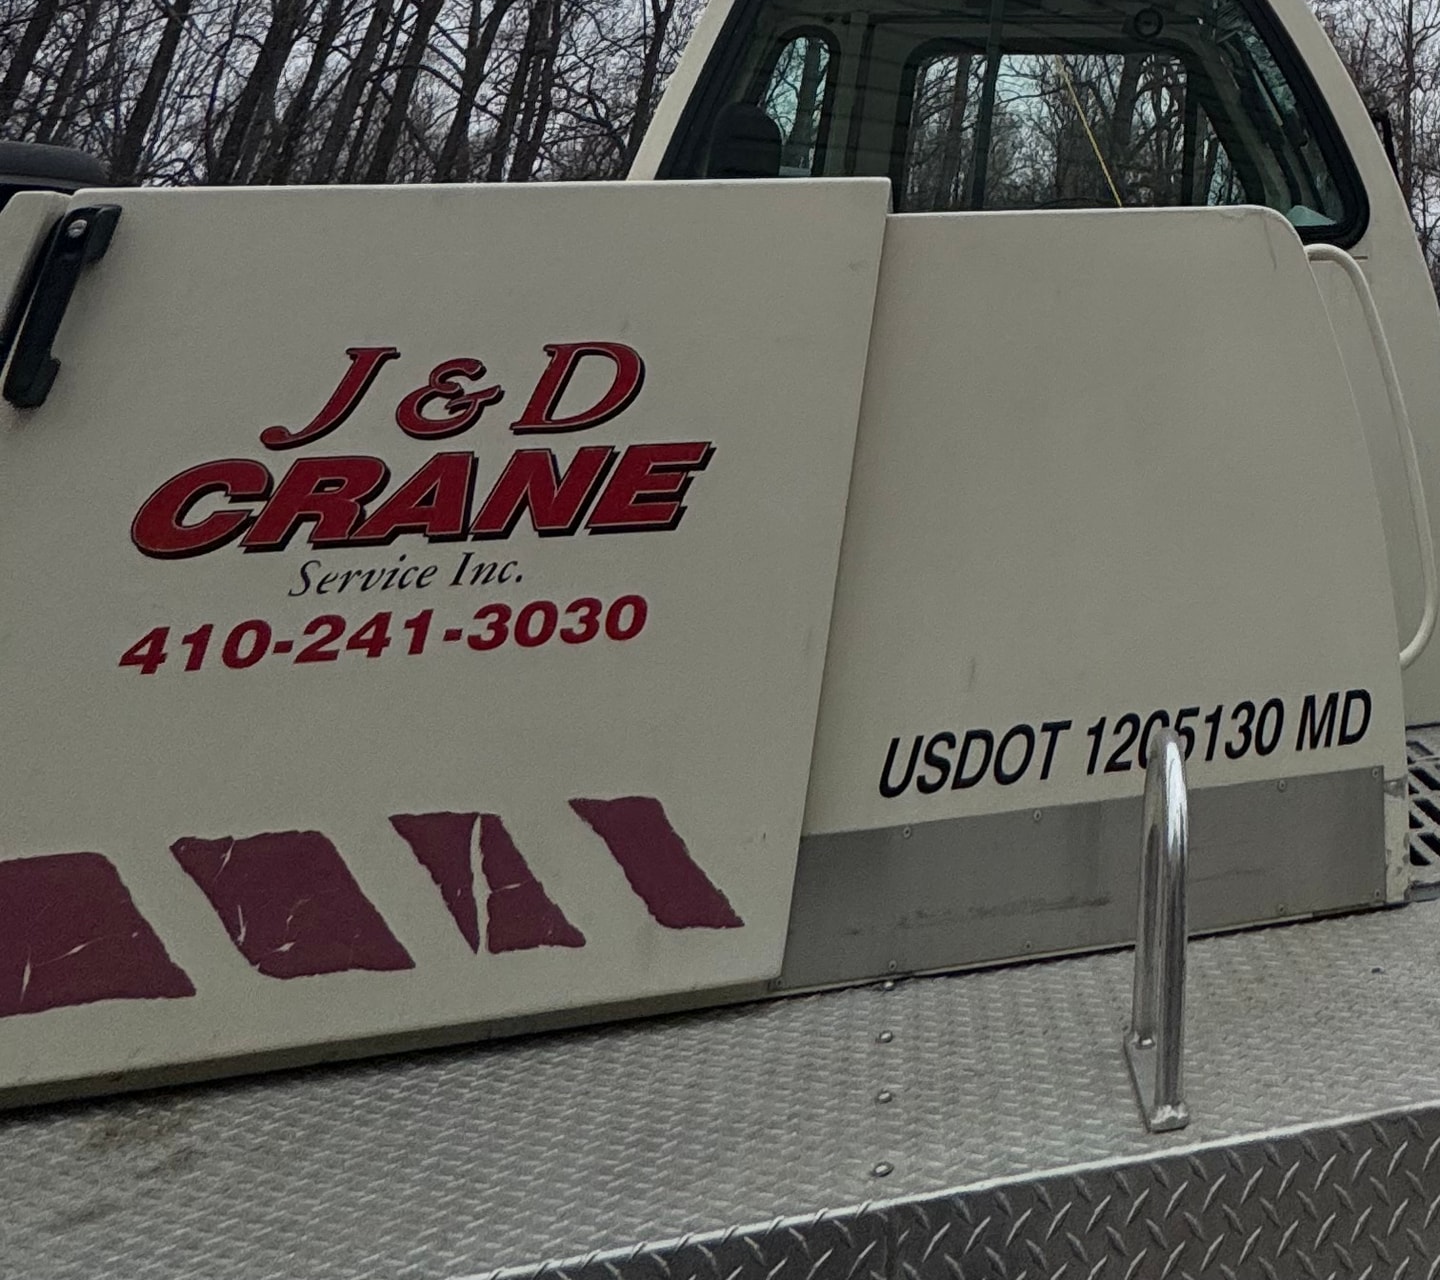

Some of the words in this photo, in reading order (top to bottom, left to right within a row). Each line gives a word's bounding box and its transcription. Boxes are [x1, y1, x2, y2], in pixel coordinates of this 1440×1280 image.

[260, 346, 401, 451] J
[395, 357, 505, 441] &
[509, 341, 646, 436] D
[130, 442, 717, 560] CRANE
[288, 554, 439, 598] Service
[449, 550, 524, 588] Inc.
[118, 594, 649, 675] 410-241-3030
[878, 719, 1073, 799] USDOT
[1295, 688, 1373, 753] MD
